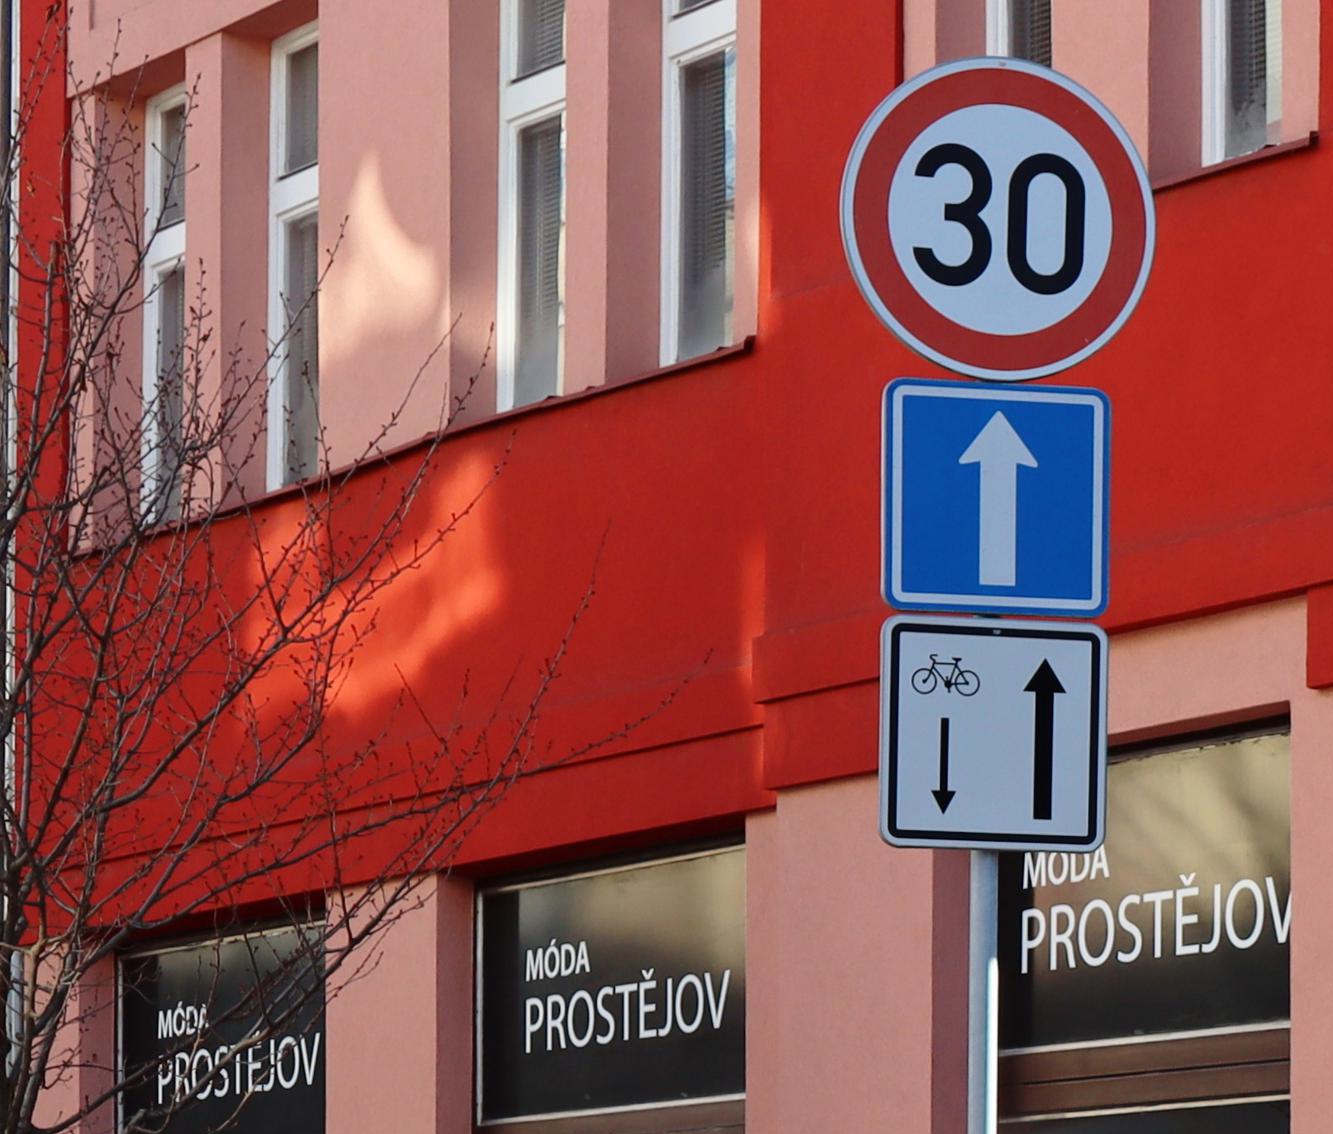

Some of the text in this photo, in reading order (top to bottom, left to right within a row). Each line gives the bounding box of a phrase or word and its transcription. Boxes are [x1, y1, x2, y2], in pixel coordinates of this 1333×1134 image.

[911, 142, 1086, 295] 30
[525, 938, 590, 982] MÓDA
[1021, 872, 1292, 974] PROSTĚJOV
[158, 1001, 210, 1039] MÓDA
[525, 968, 731, 1054] PROSTĚJOV
